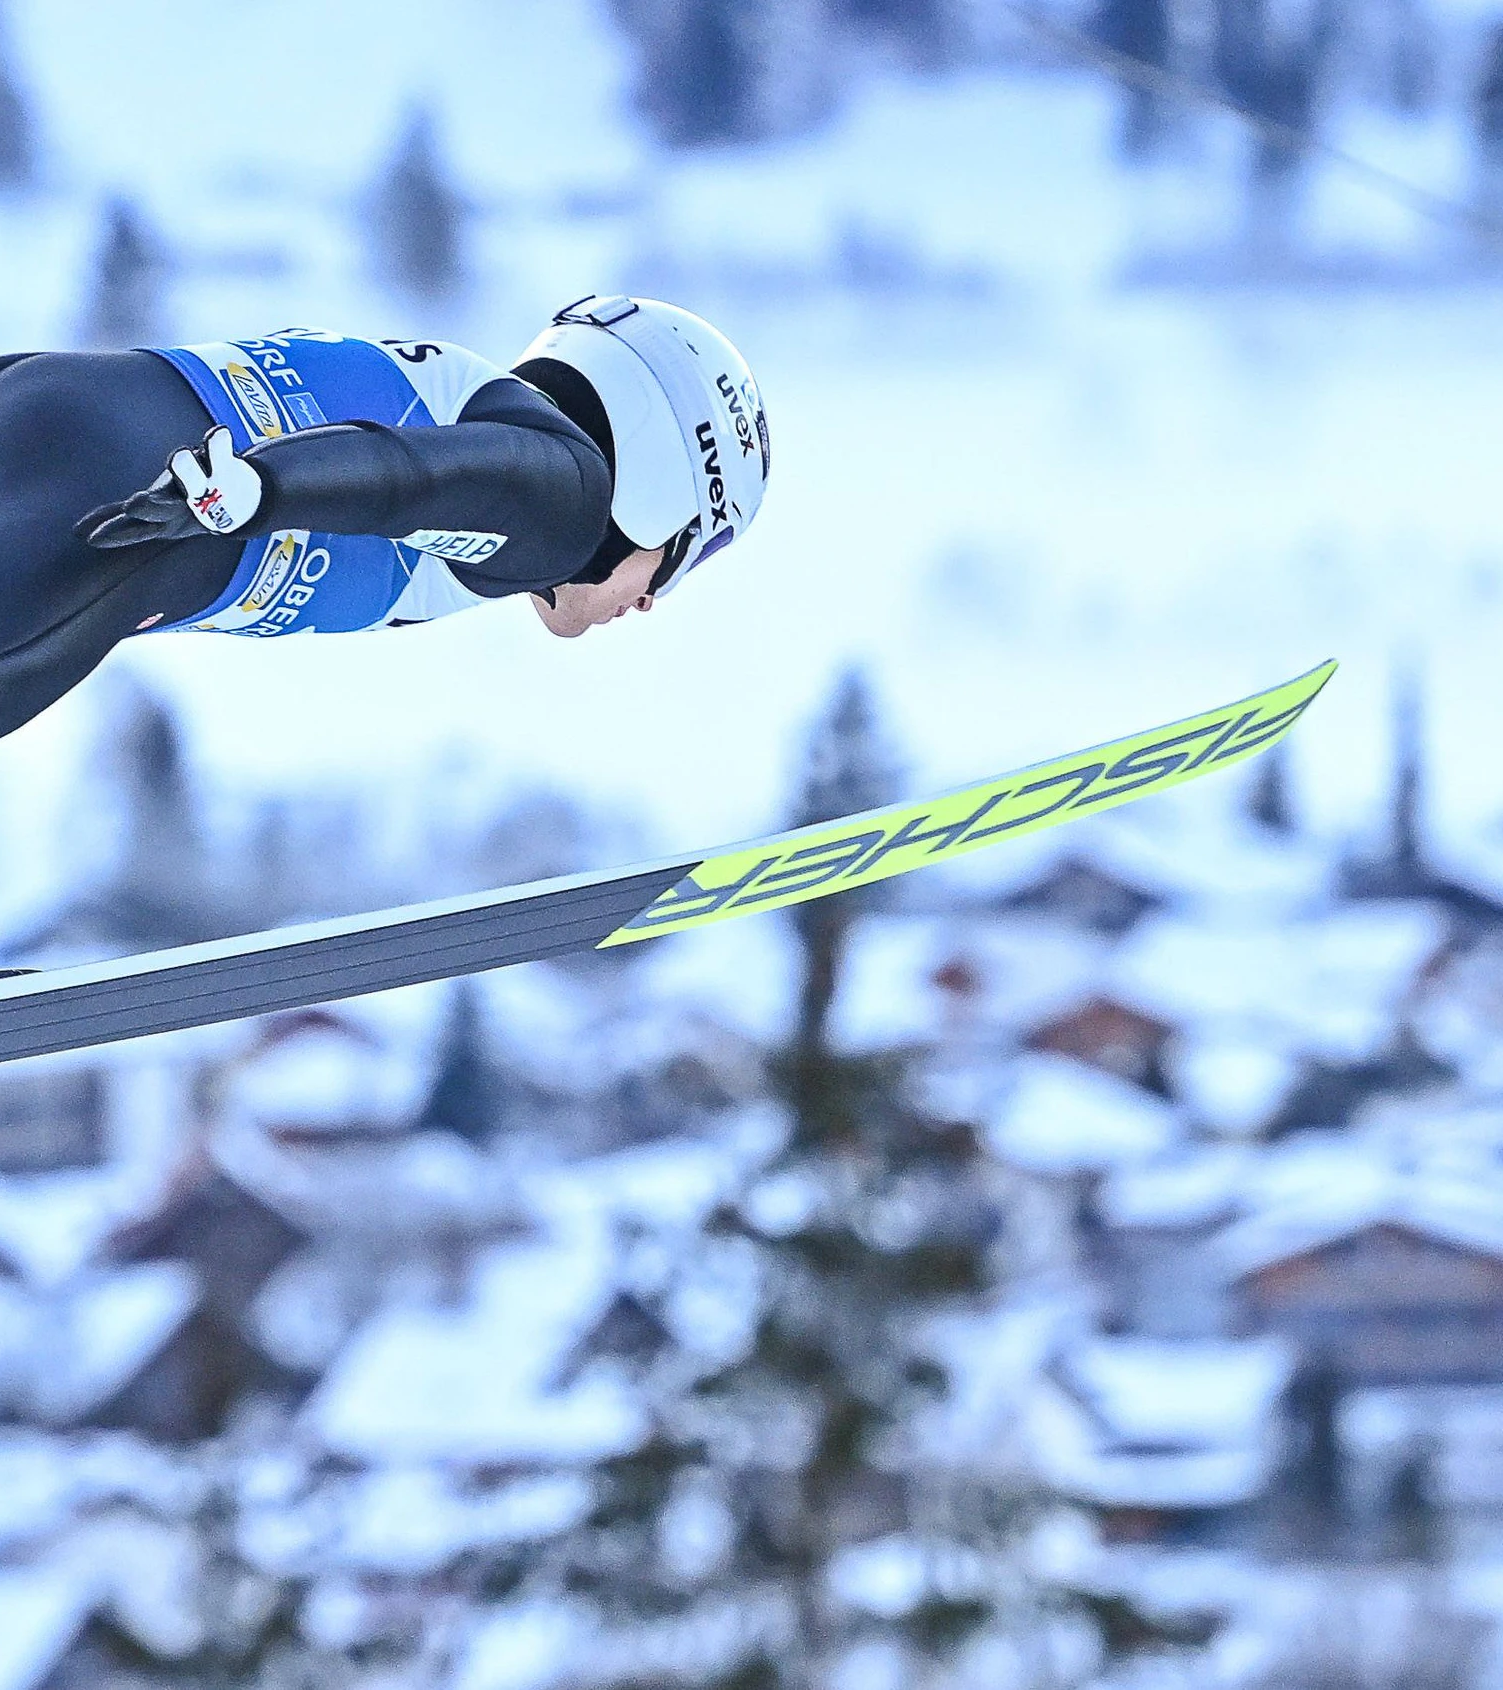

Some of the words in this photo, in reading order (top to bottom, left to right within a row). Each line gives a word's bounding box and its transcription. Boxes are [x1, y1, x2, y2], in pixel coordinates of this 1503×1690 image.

[715, 373, 755, 458] uvex
[695, 420, 728, 531] uvex
[418, 535, 498, 559] HELP
[622, 694, 1317, 930] FISCHER
